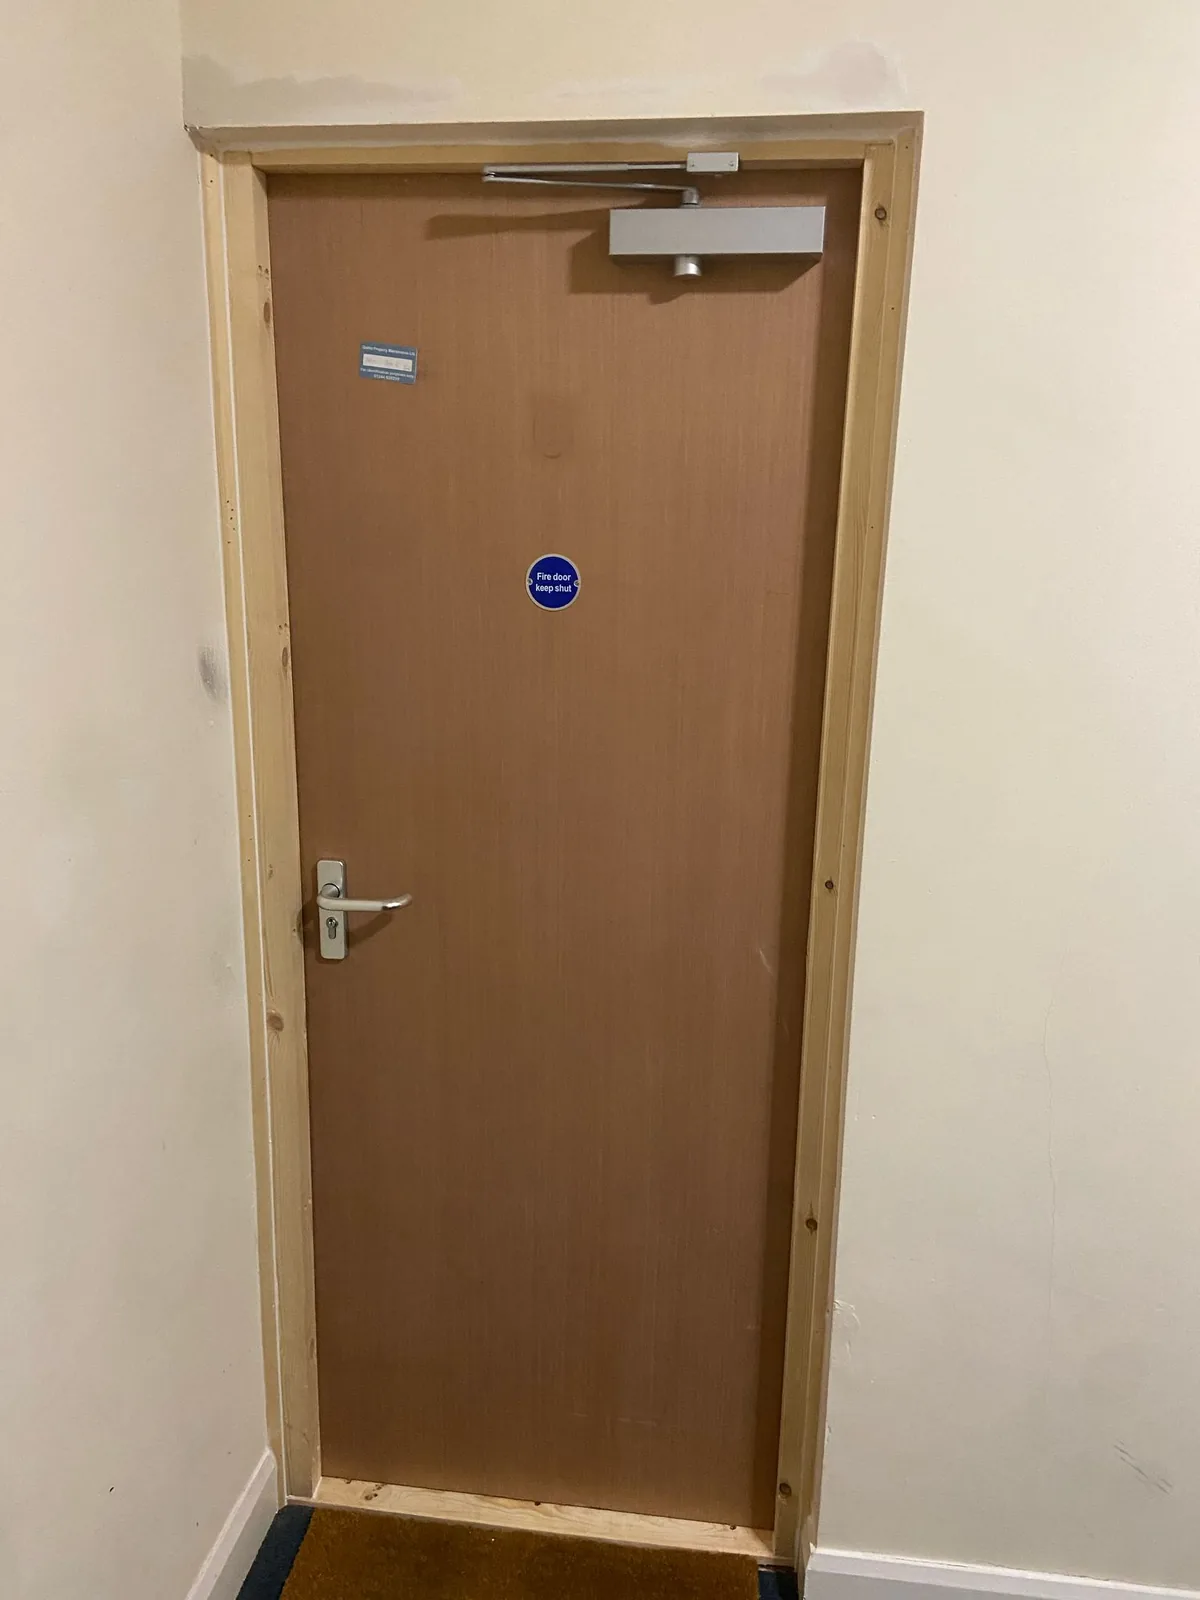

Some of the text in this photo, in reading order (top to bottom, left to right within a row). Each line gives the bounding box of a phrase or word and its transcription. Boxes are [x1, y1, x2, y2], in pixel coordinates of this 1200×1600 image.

[536, 572, 572, 581] Fire door
[535, 583, 572, 594] keep shut
